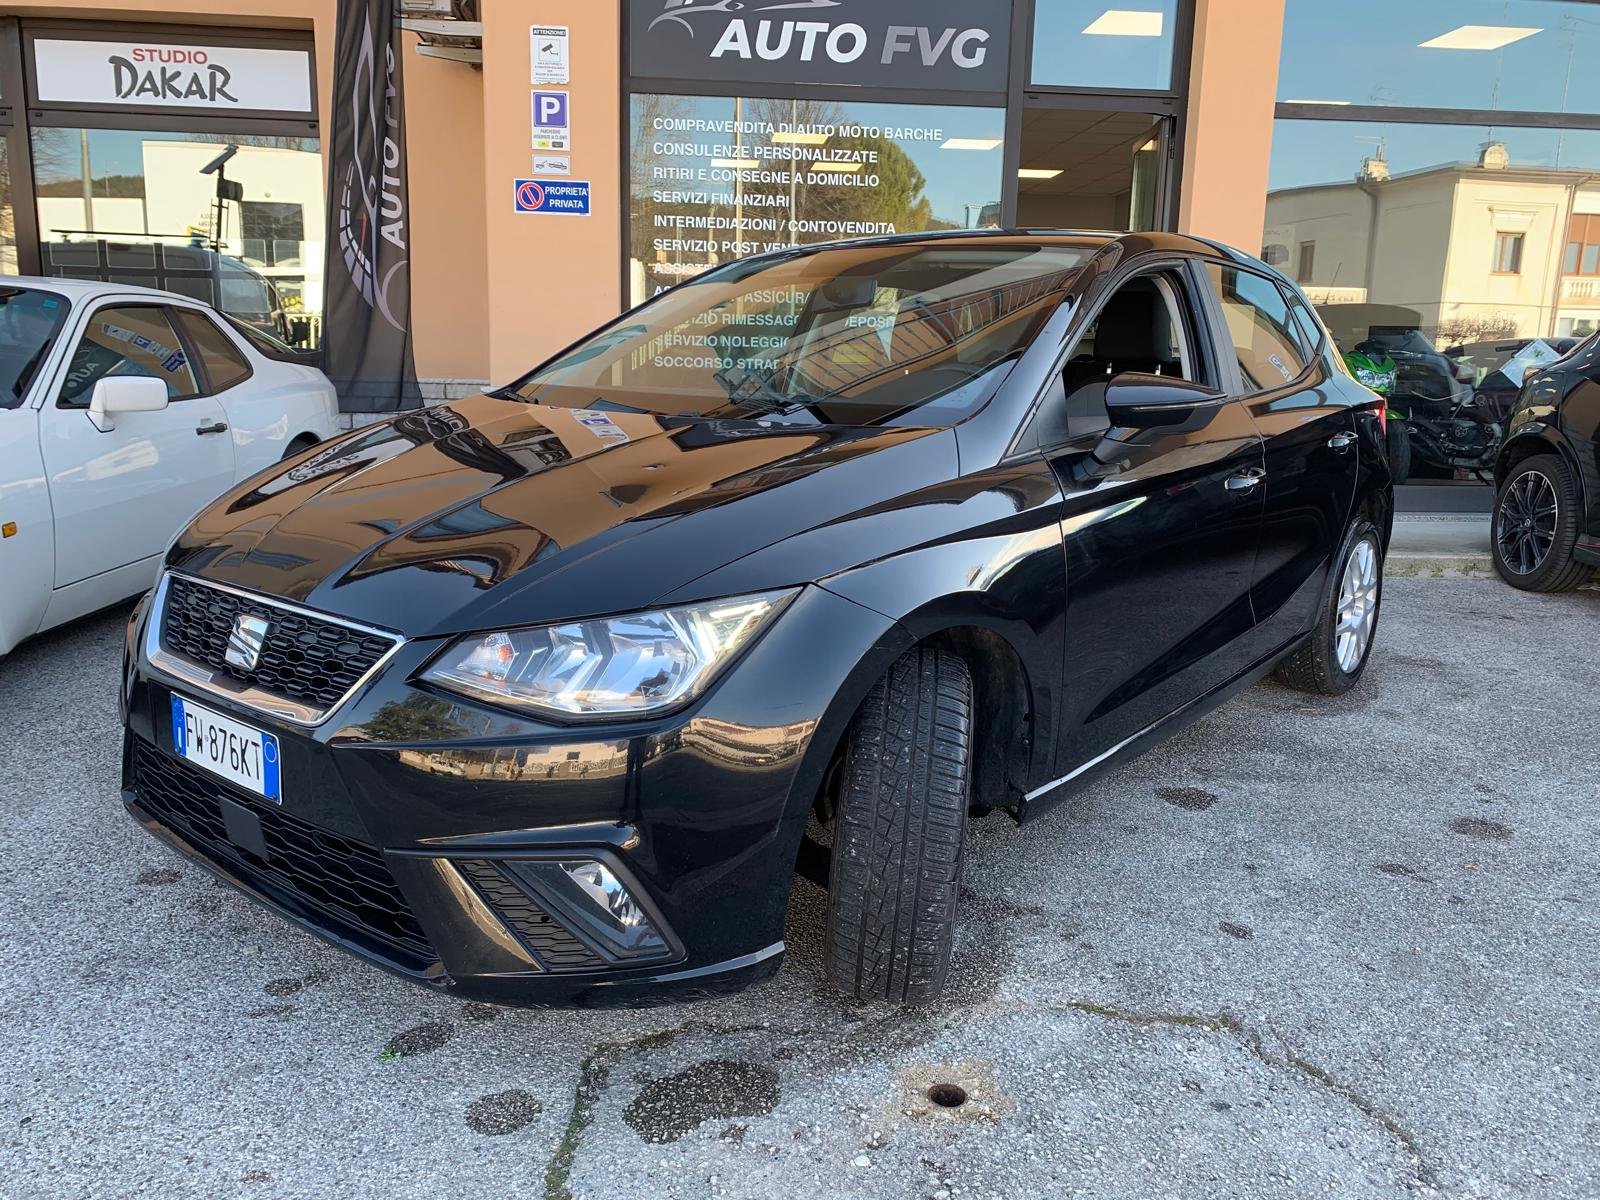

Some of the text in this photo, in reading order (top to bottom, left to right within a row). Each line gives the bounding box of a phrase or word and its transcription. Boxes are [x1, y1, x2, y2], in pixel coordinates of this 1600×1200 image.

[710, 19, 990, 69] AUTO FVG
[133, 48, 208, 65] STUDIO
[108, 55, 239, 103] DAKAR
[541, 96, 560, 123] P
[653, 117, 943, 141] COMPRAVENDITA DI AUTO MOTO BARCHE
[653, 142, 878, 163] CONSULENZE PERSONALIZZATE
[653, 167, 880, 187] RITIRI E CONSEGNE A DOMICILIO
[381, 136, 406, 250] AUTO
[653, 190, 790, 208] SERVIZI FINANZIARI
[549, 199, 584, 209] PRIVATA
[654, 215, 896, 234] INTERMEDIAZIONI / CONTOVENDITA
[653, 239, 717, 252] SERVIZIO
[722, 241, 759, 254] POST
[653, 334, 718, 347] SERVIZIO
[654, 356, 733, 369] SOCCORSO
